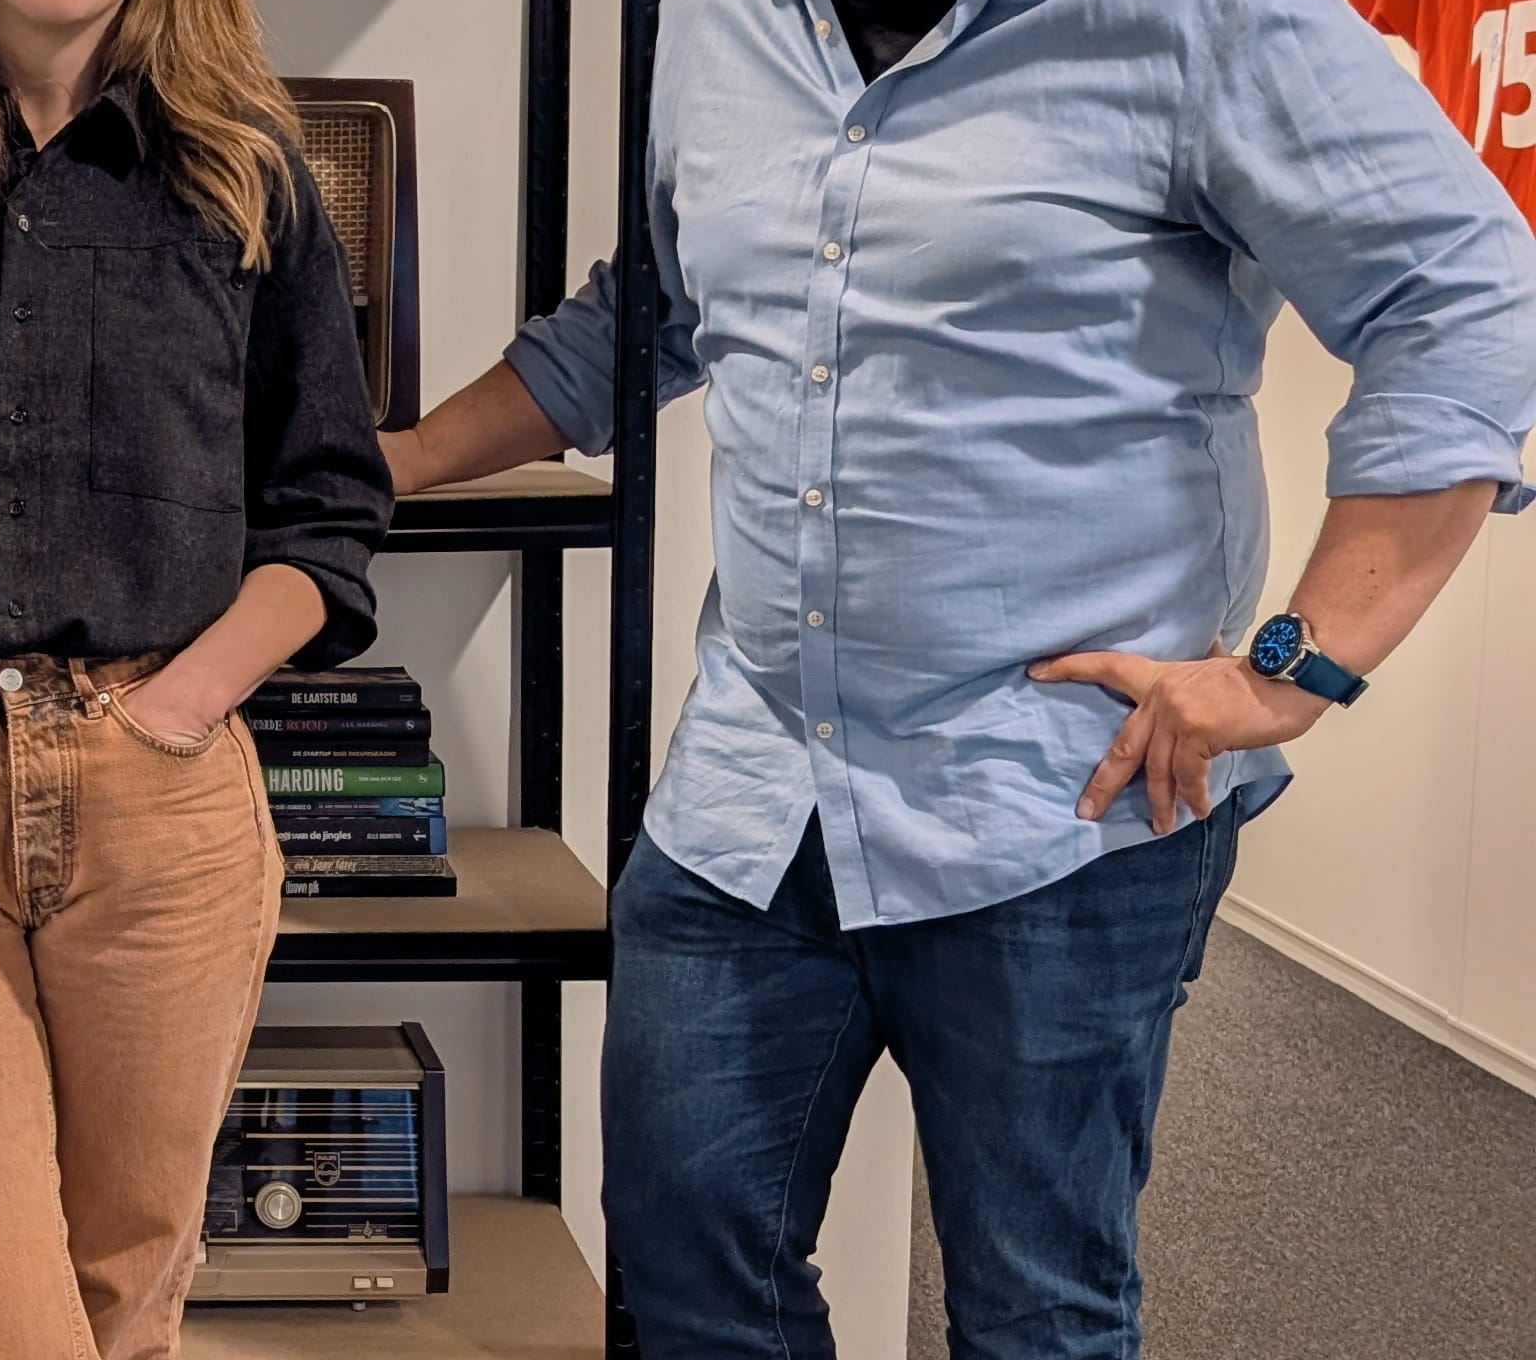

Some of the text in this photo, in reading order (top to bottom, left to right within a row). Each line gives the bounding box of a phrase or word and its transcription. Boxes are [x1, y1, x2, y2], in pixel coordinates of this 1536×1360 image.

[291, 692, 303, 704] DE
[304, 692, 339, 704] LAATSTE
[340, 692, 358, 704] DAG
[268, 768, 344, 792] HARDING
[309, 830, 322, 840] de
[322, 830, 352, 842] jingles
